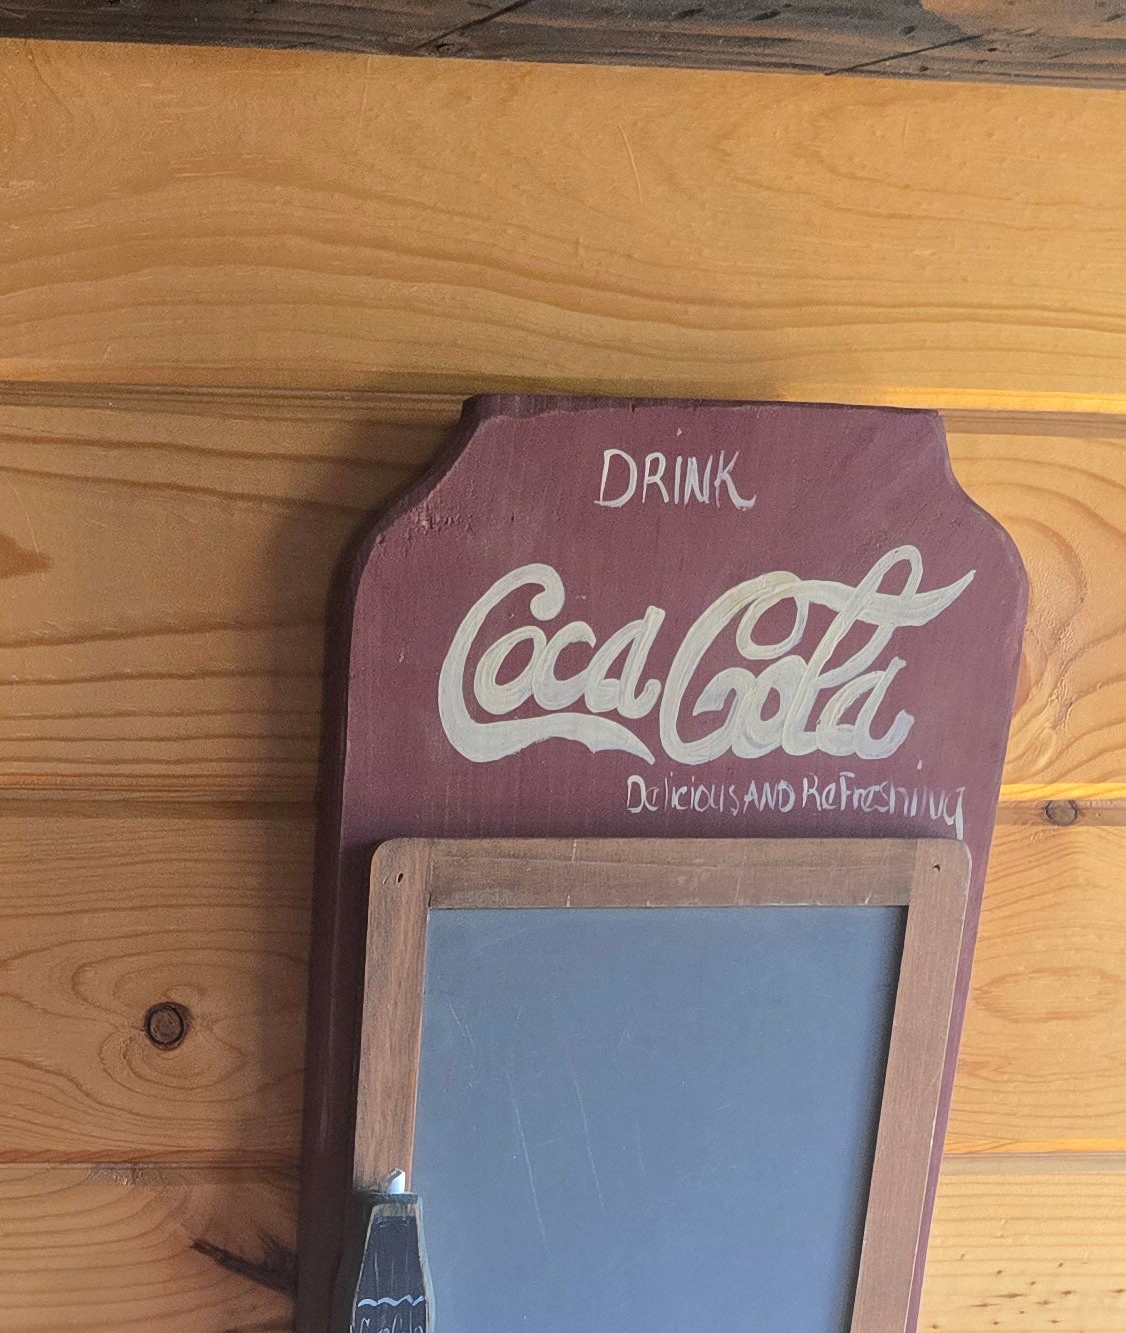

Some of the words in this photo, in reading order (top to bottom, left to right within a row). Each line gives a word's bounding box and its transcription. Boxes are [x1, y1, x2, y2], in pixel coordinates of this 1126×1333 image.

[594, 449, 756, 510] DRINK
[437, 562, 665, 766] Coca
[660, 544, 977, 766] Cola
[626, 772, 739, 816] Delicious
[744, 779, 795, 815] AND
